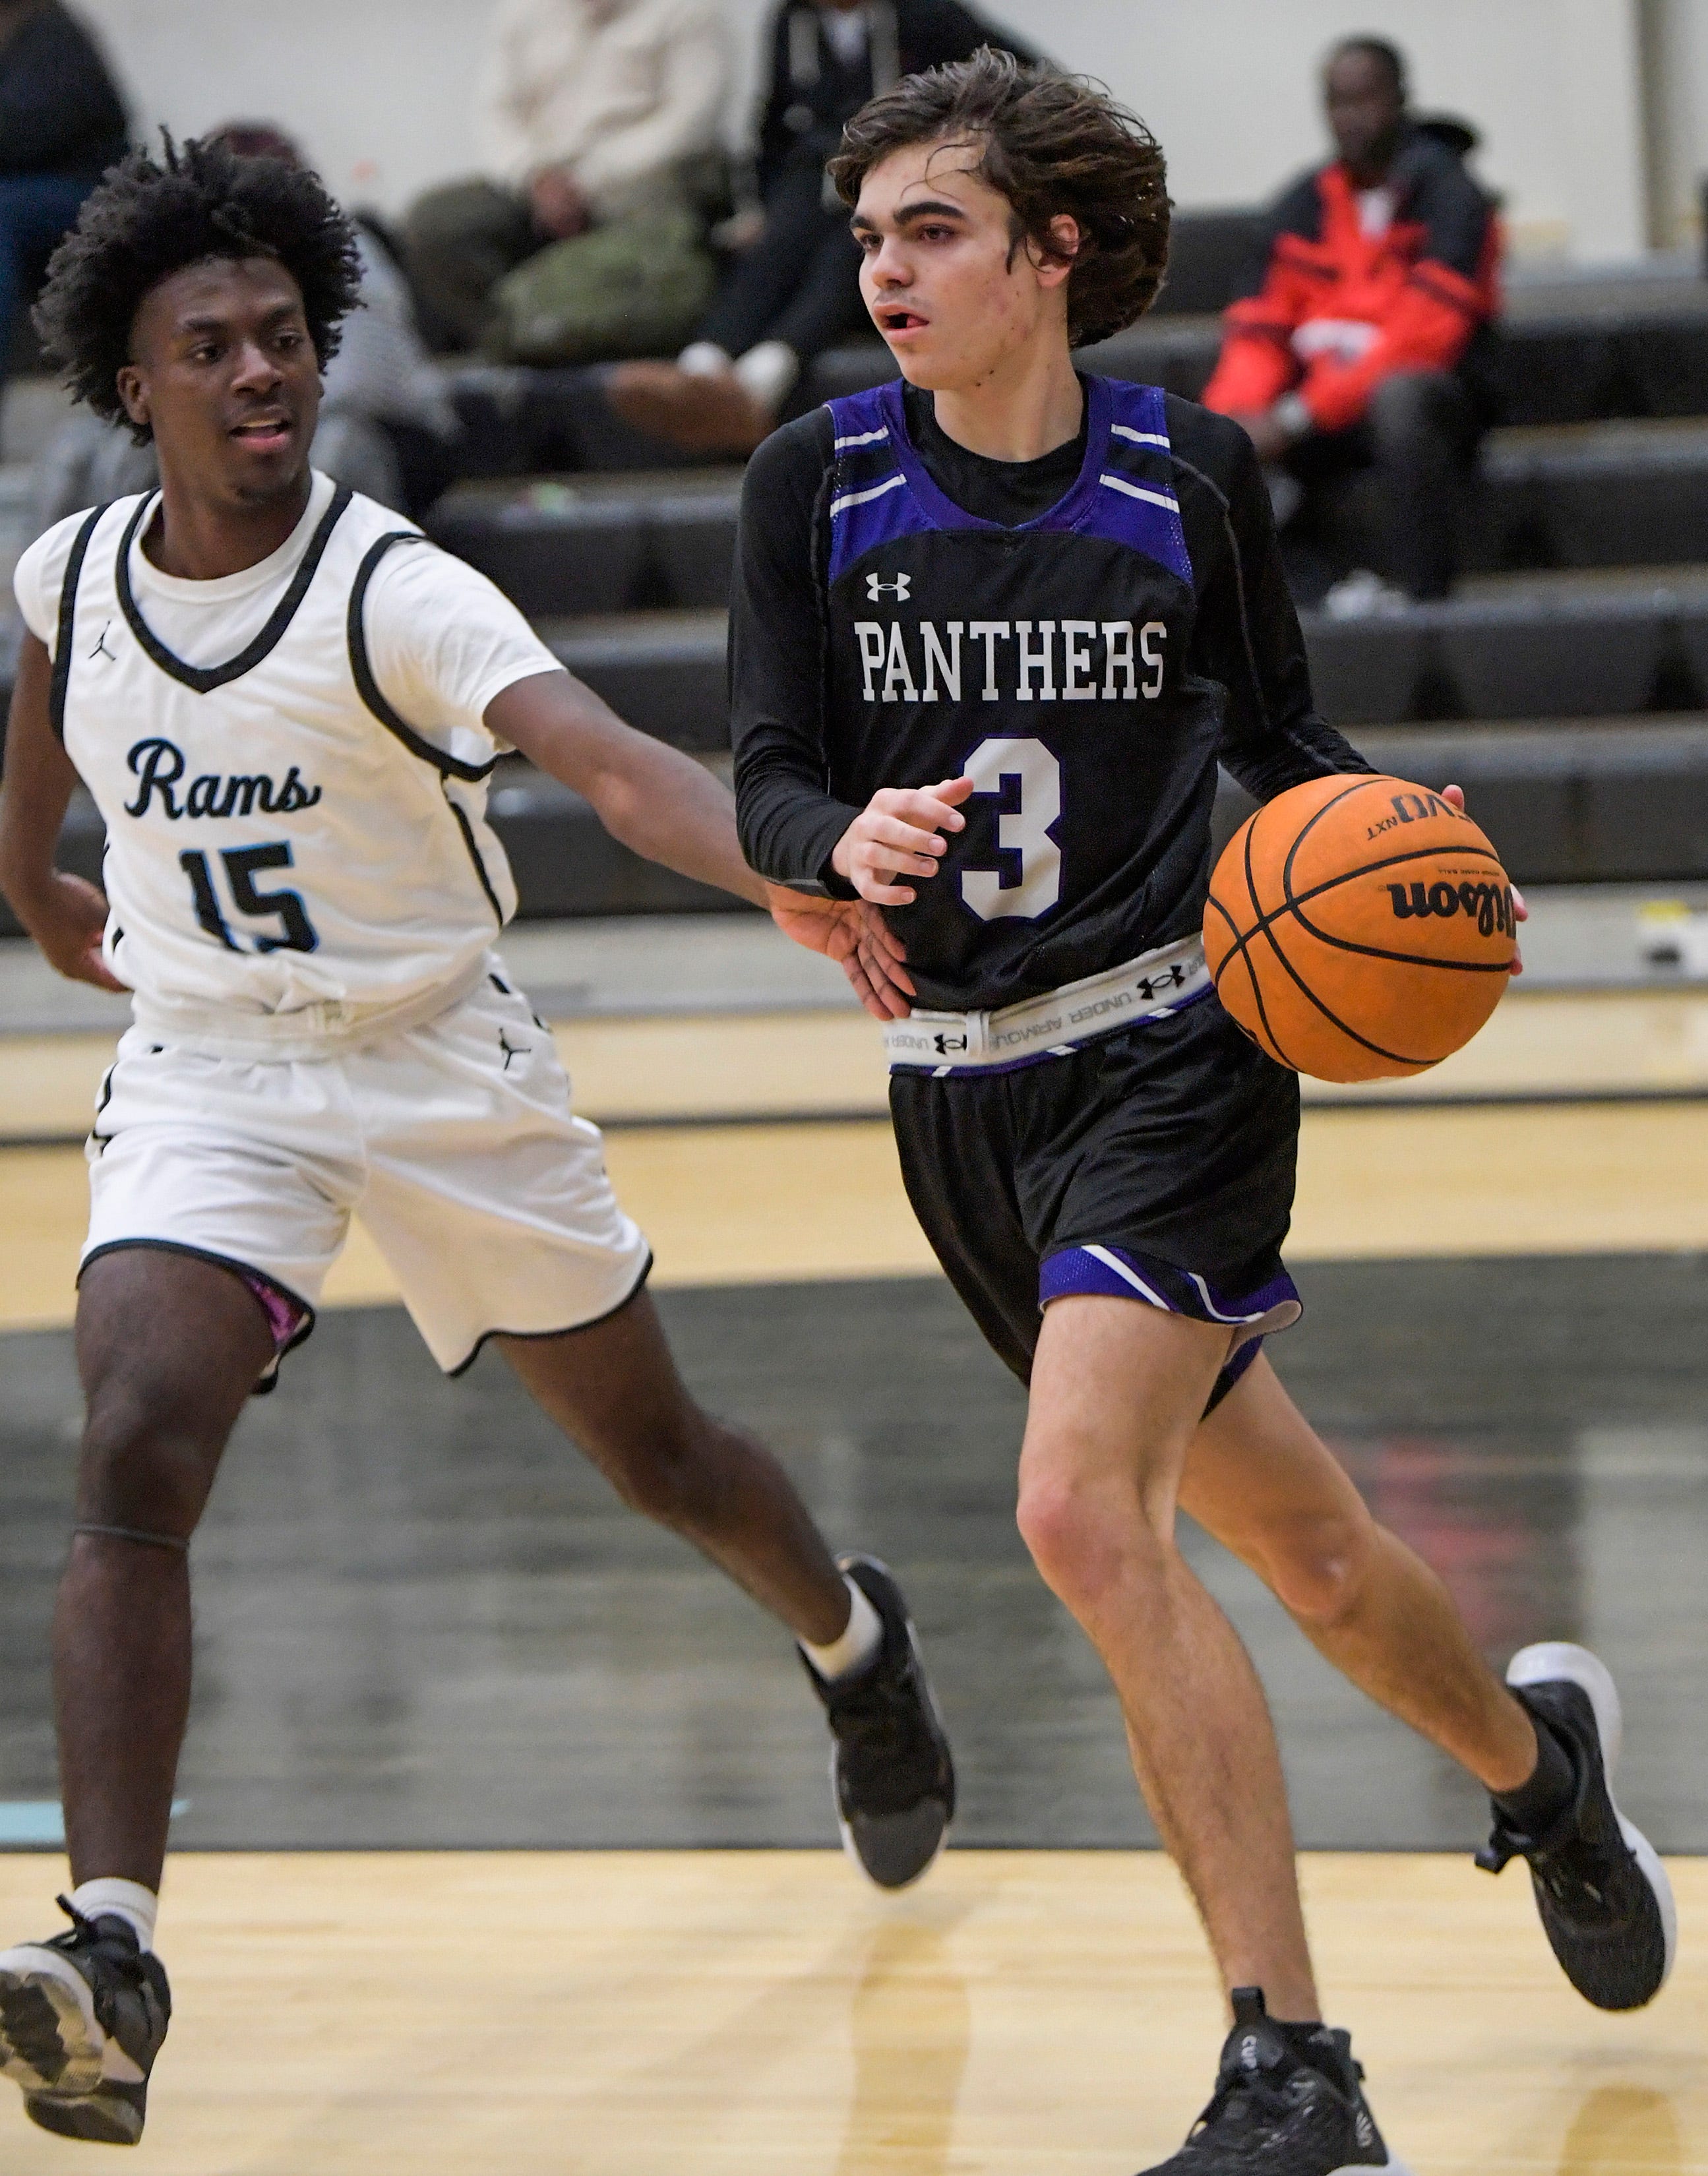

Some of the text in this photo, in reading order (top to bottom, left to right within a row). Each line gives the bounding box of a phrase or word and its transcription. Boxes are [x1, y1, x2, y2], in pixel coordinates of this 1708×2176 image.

[854, 620, 1167, 702] PANTHERS
[124, 737, 322, 820] Rams
[961, 737, 1063, 922] 3
[1368, 817, 1398, 841] NXT
[179, 840, 319, 955] 15
[1068, 992, 1132, 1024] UNDER
